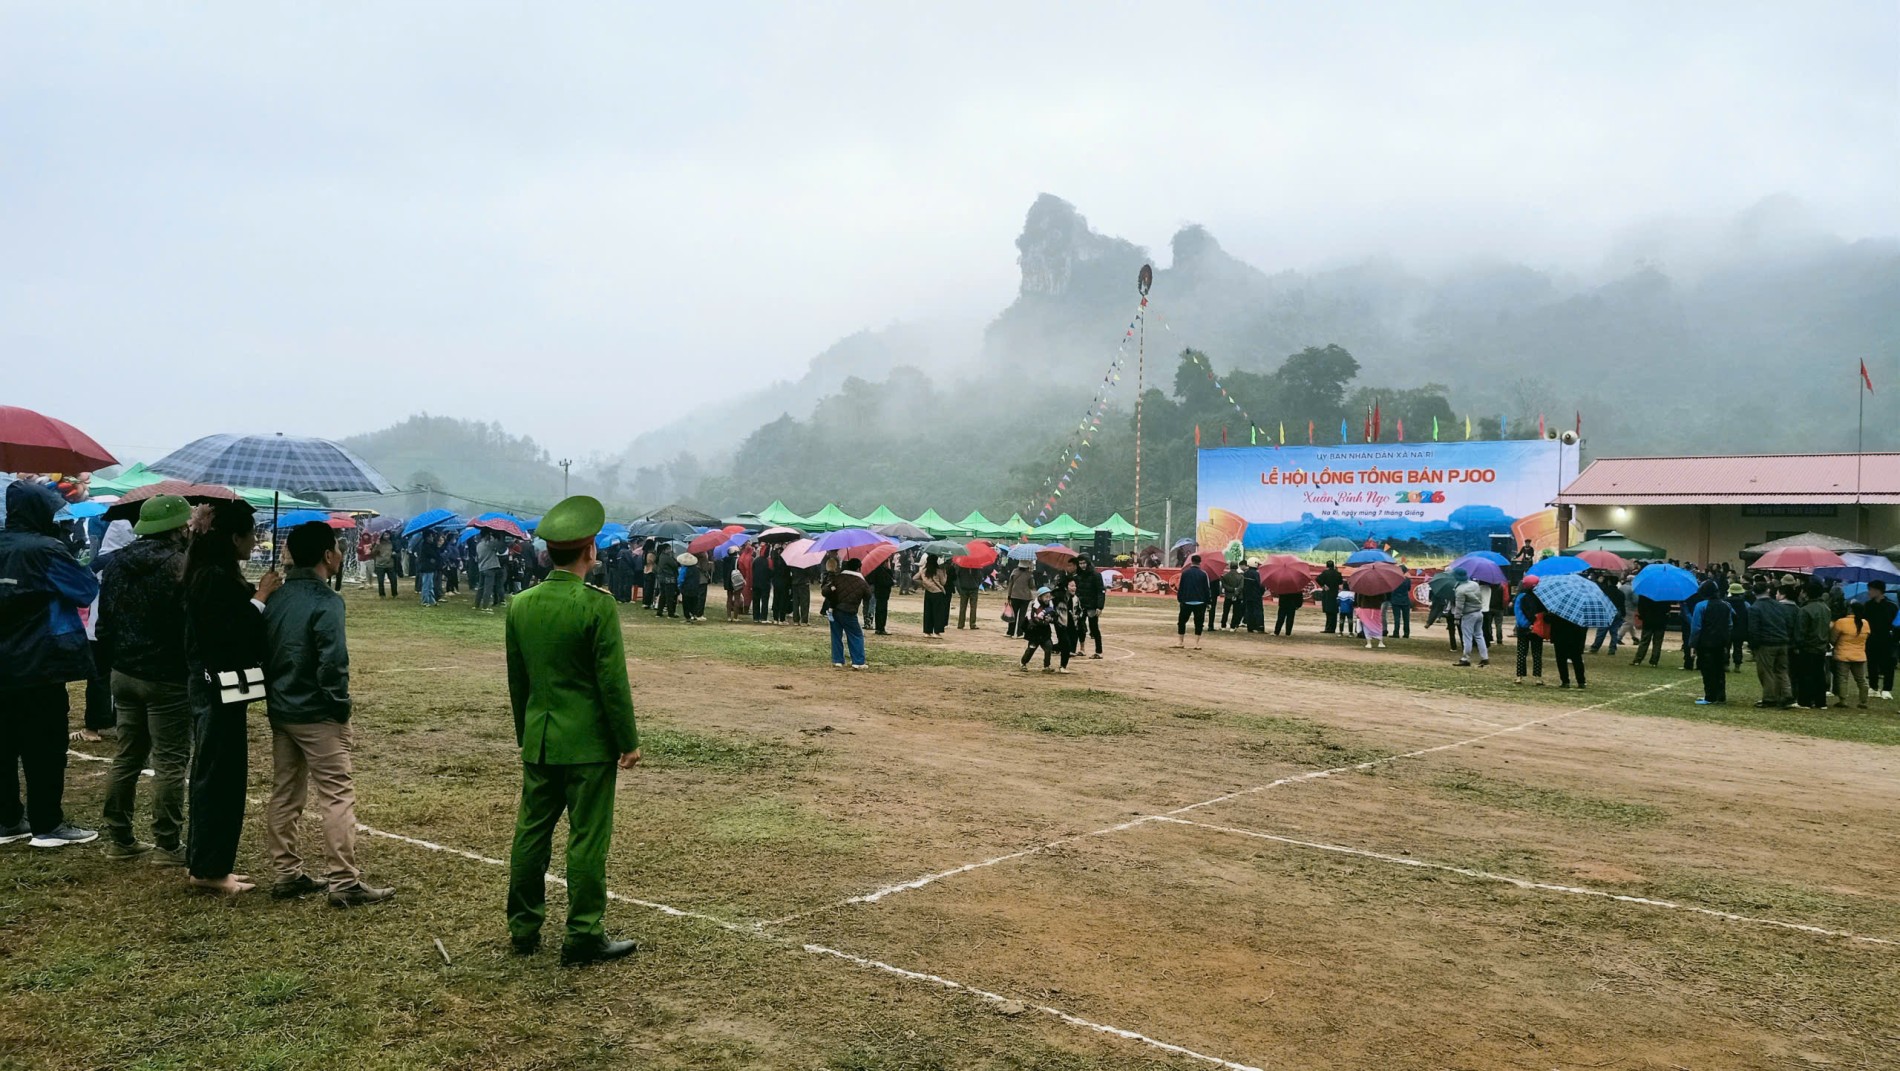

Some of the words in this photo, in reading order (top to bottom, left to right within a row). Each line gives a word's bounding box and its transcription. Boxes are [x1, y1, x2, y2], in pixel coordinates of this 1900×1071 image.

[1330, 452, 1347, 460] BAN
[1261, 467, 1278, 485] LỄ
[1282, 469, 1308, 487] HỘI
[1448, 469, 1495, 483] PJOO
[1303, 490, 1334, 503] Xuân
[1395, 490, 1445, 504] 2026
